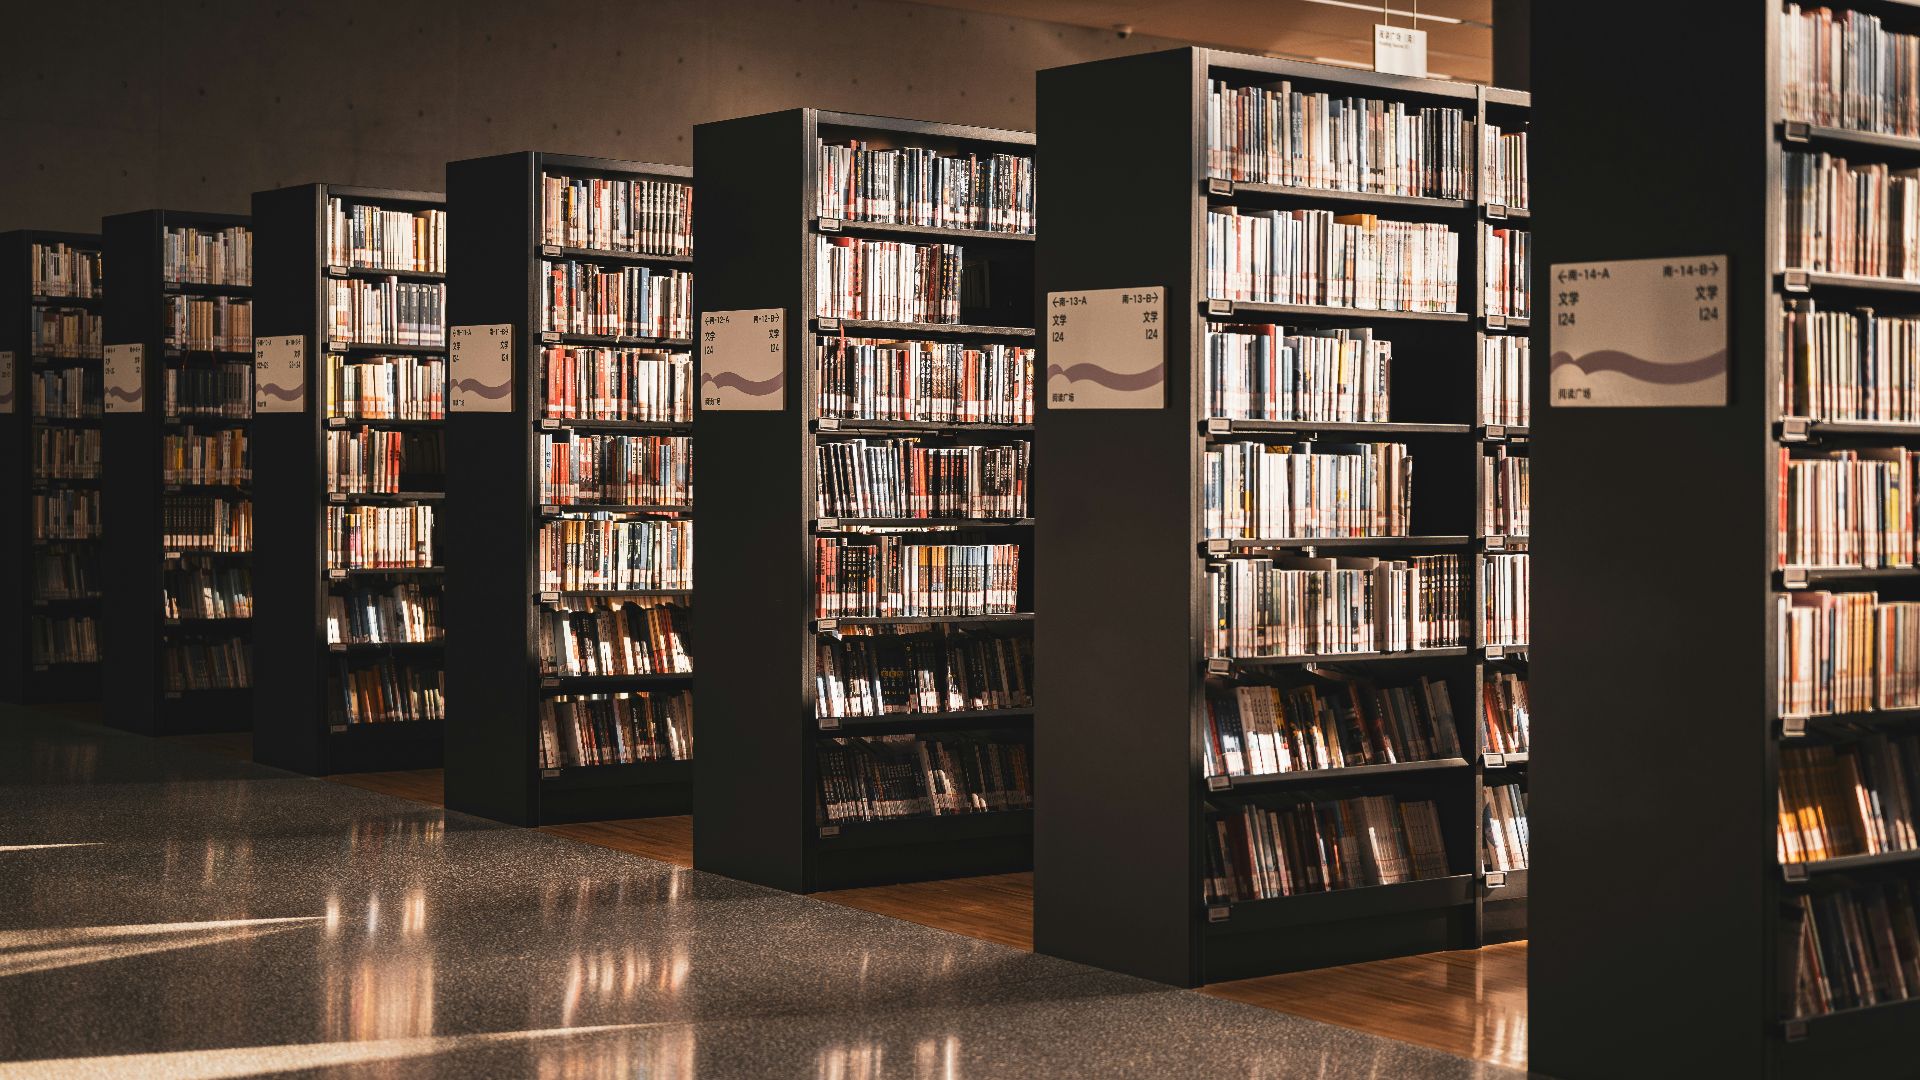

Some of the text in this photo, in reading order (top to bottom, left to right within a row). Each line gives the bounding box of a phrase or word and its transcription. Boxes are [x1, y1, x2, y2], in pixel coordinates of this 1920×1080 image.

[1568, 268, 1610, 280] 南-14-A
[1696, 285, 1718, 300] 文学
[1059, 296, 1087, 306] 南-13-A
[1122, 294, 1152, 304] 南-13-B
[1558, 292, 1579, 306] 文学
[1053, 315, 1066, 326] 文学
[1143, 311, 1157, 323] 文学
